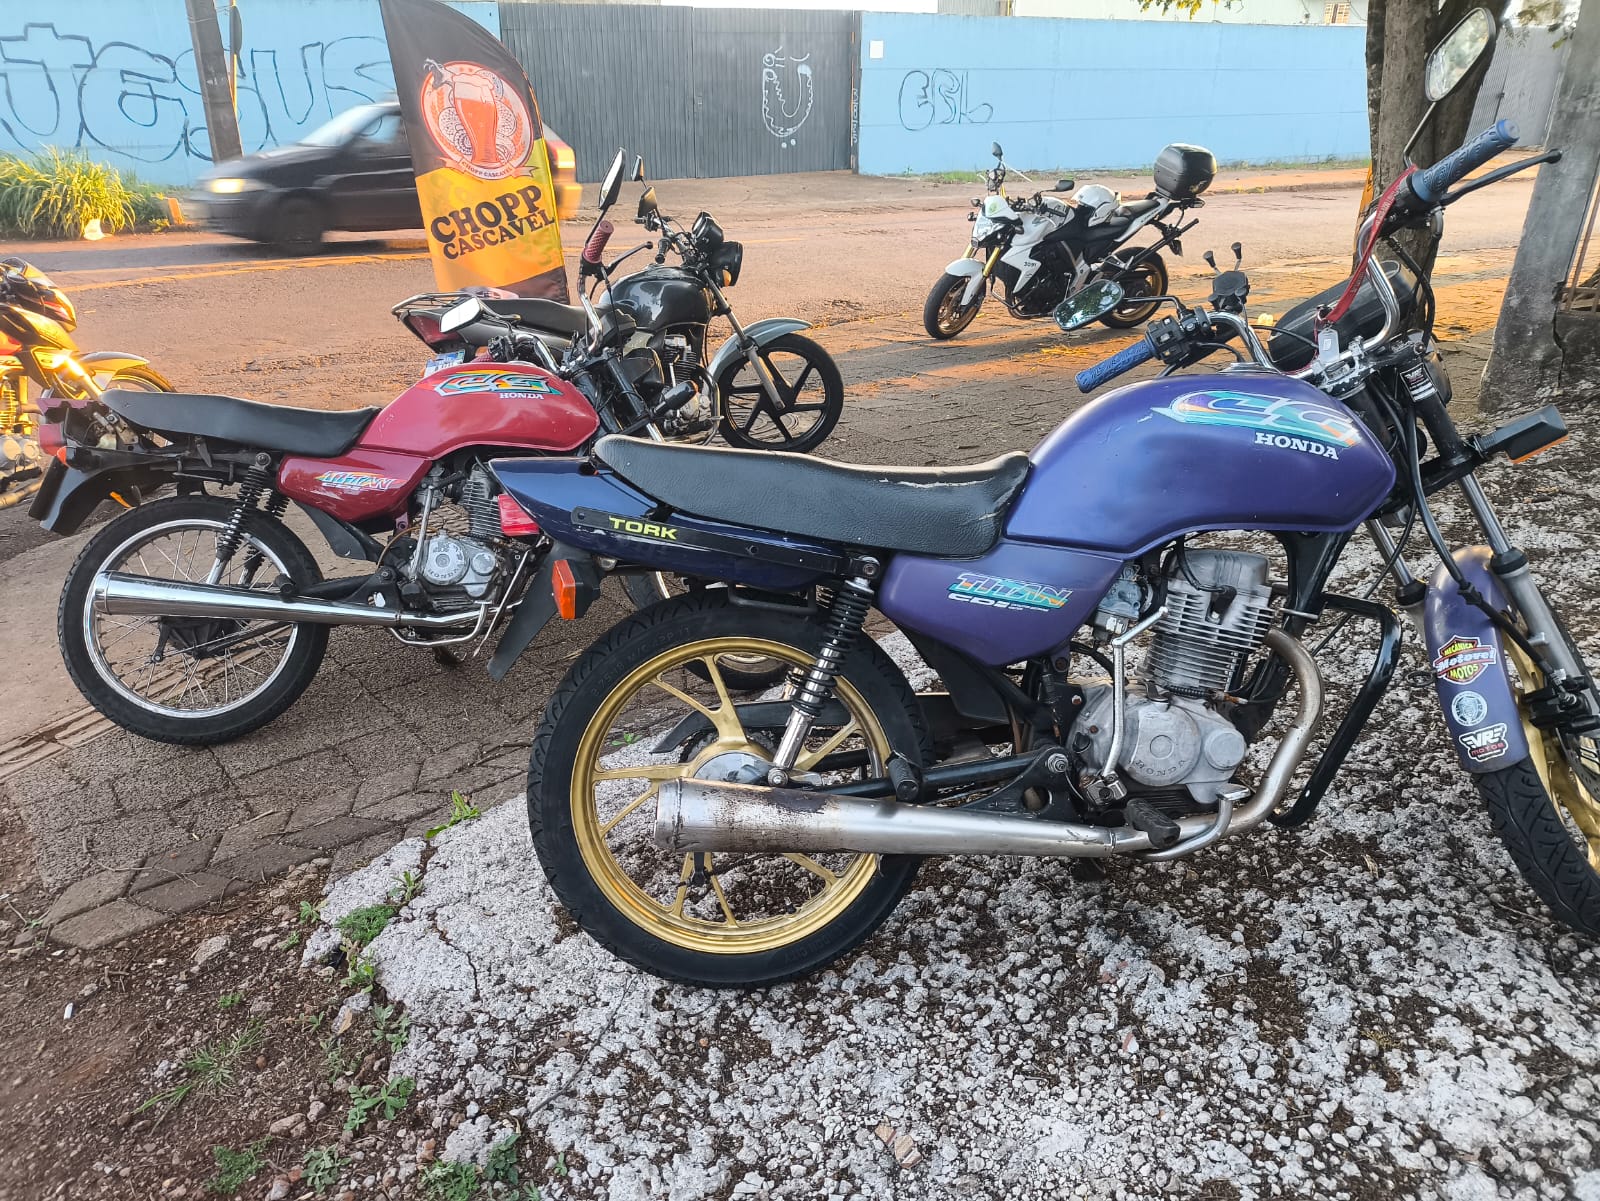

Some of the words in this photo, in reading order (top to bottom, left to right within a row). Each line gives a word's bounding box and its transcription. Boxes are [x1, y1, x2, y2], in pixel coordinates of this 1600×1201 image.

[430, 185, 542, 244] CHOPP
[443, 210, 556, 260] CASCAVEL
[499, 391, 545, 400] HONDA
[1254, 432, 1340, 461] HONDA
[608, 516, 678, 540] TORK
[956, 573, 1074, 606] TITAN
[1449, 663, 1480, 680] MOTOS
